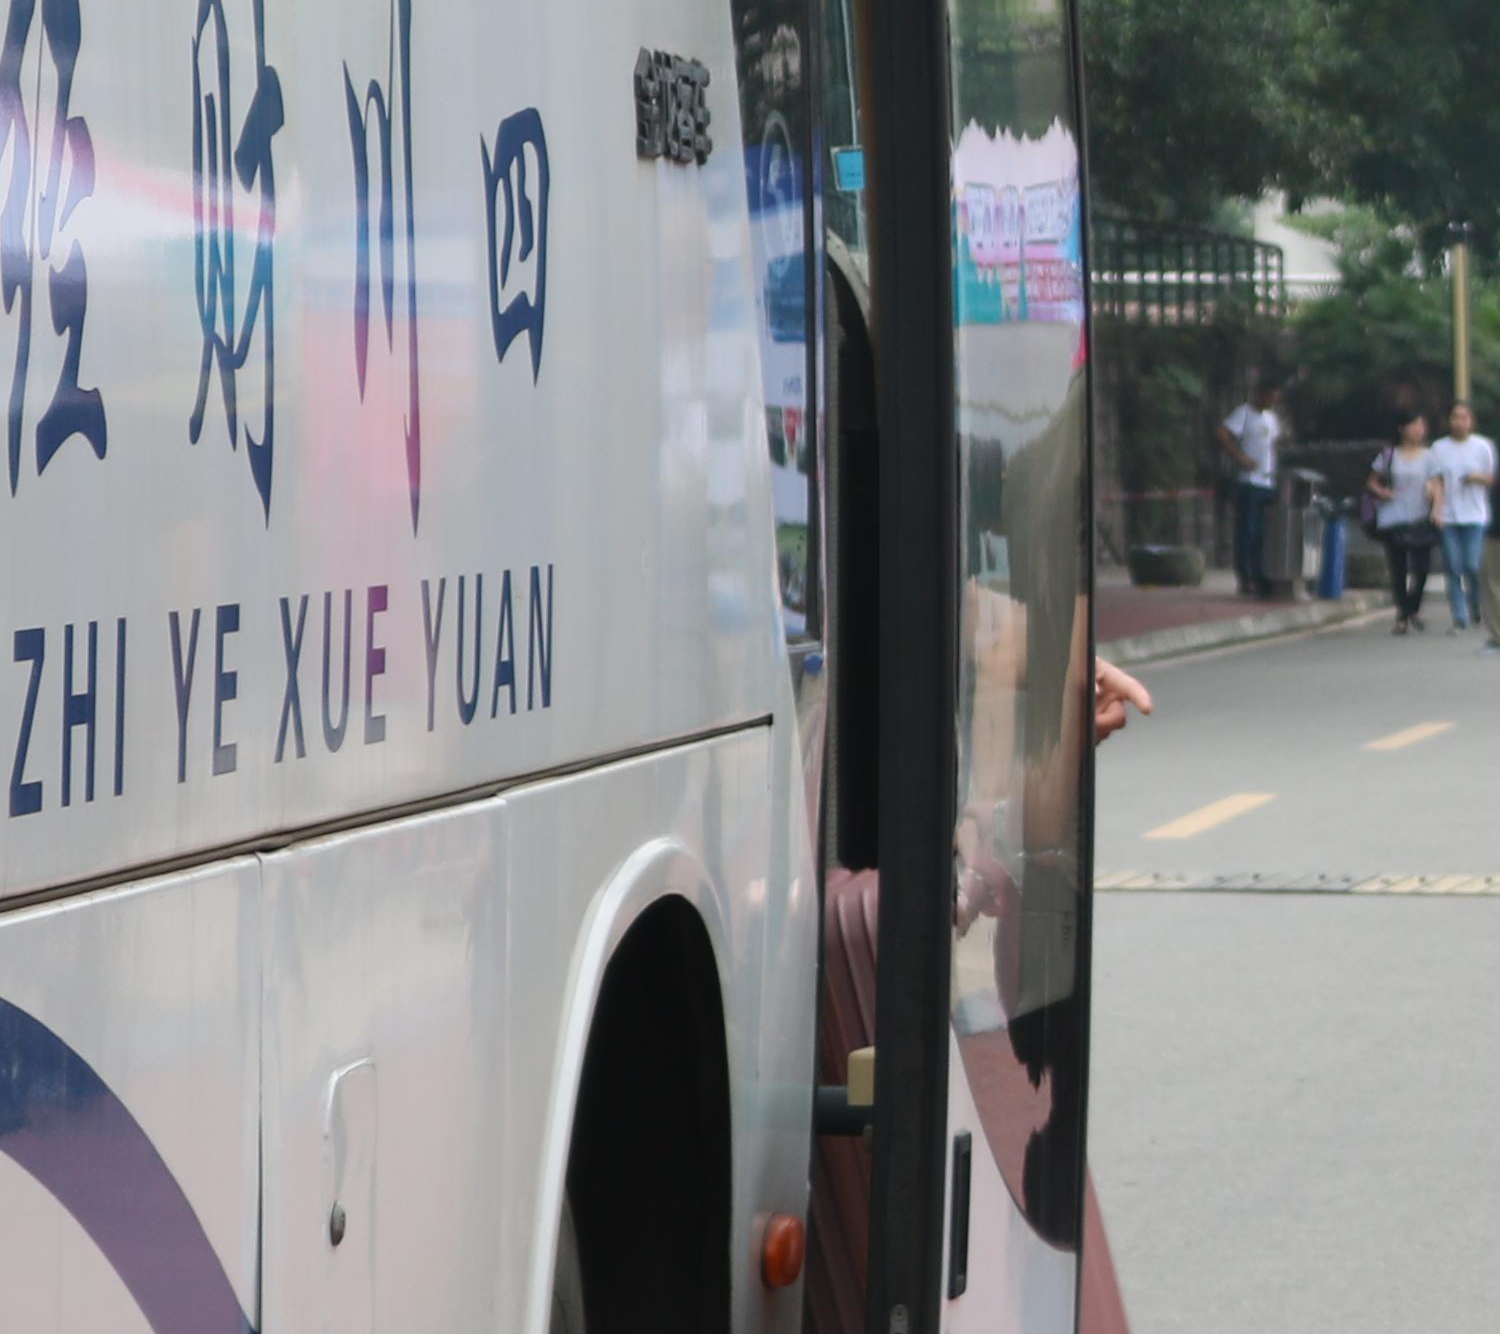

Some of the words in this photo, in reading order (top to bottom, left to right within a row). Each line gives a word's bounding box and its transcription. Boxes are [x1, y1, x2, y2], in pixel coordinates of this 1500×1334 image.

[9, 617, 127, 817] ZHI
[169, 603, 241, 784] YE
[273, 585, 388, 764] XUE
[420, 563, 554, 733] YUAN
